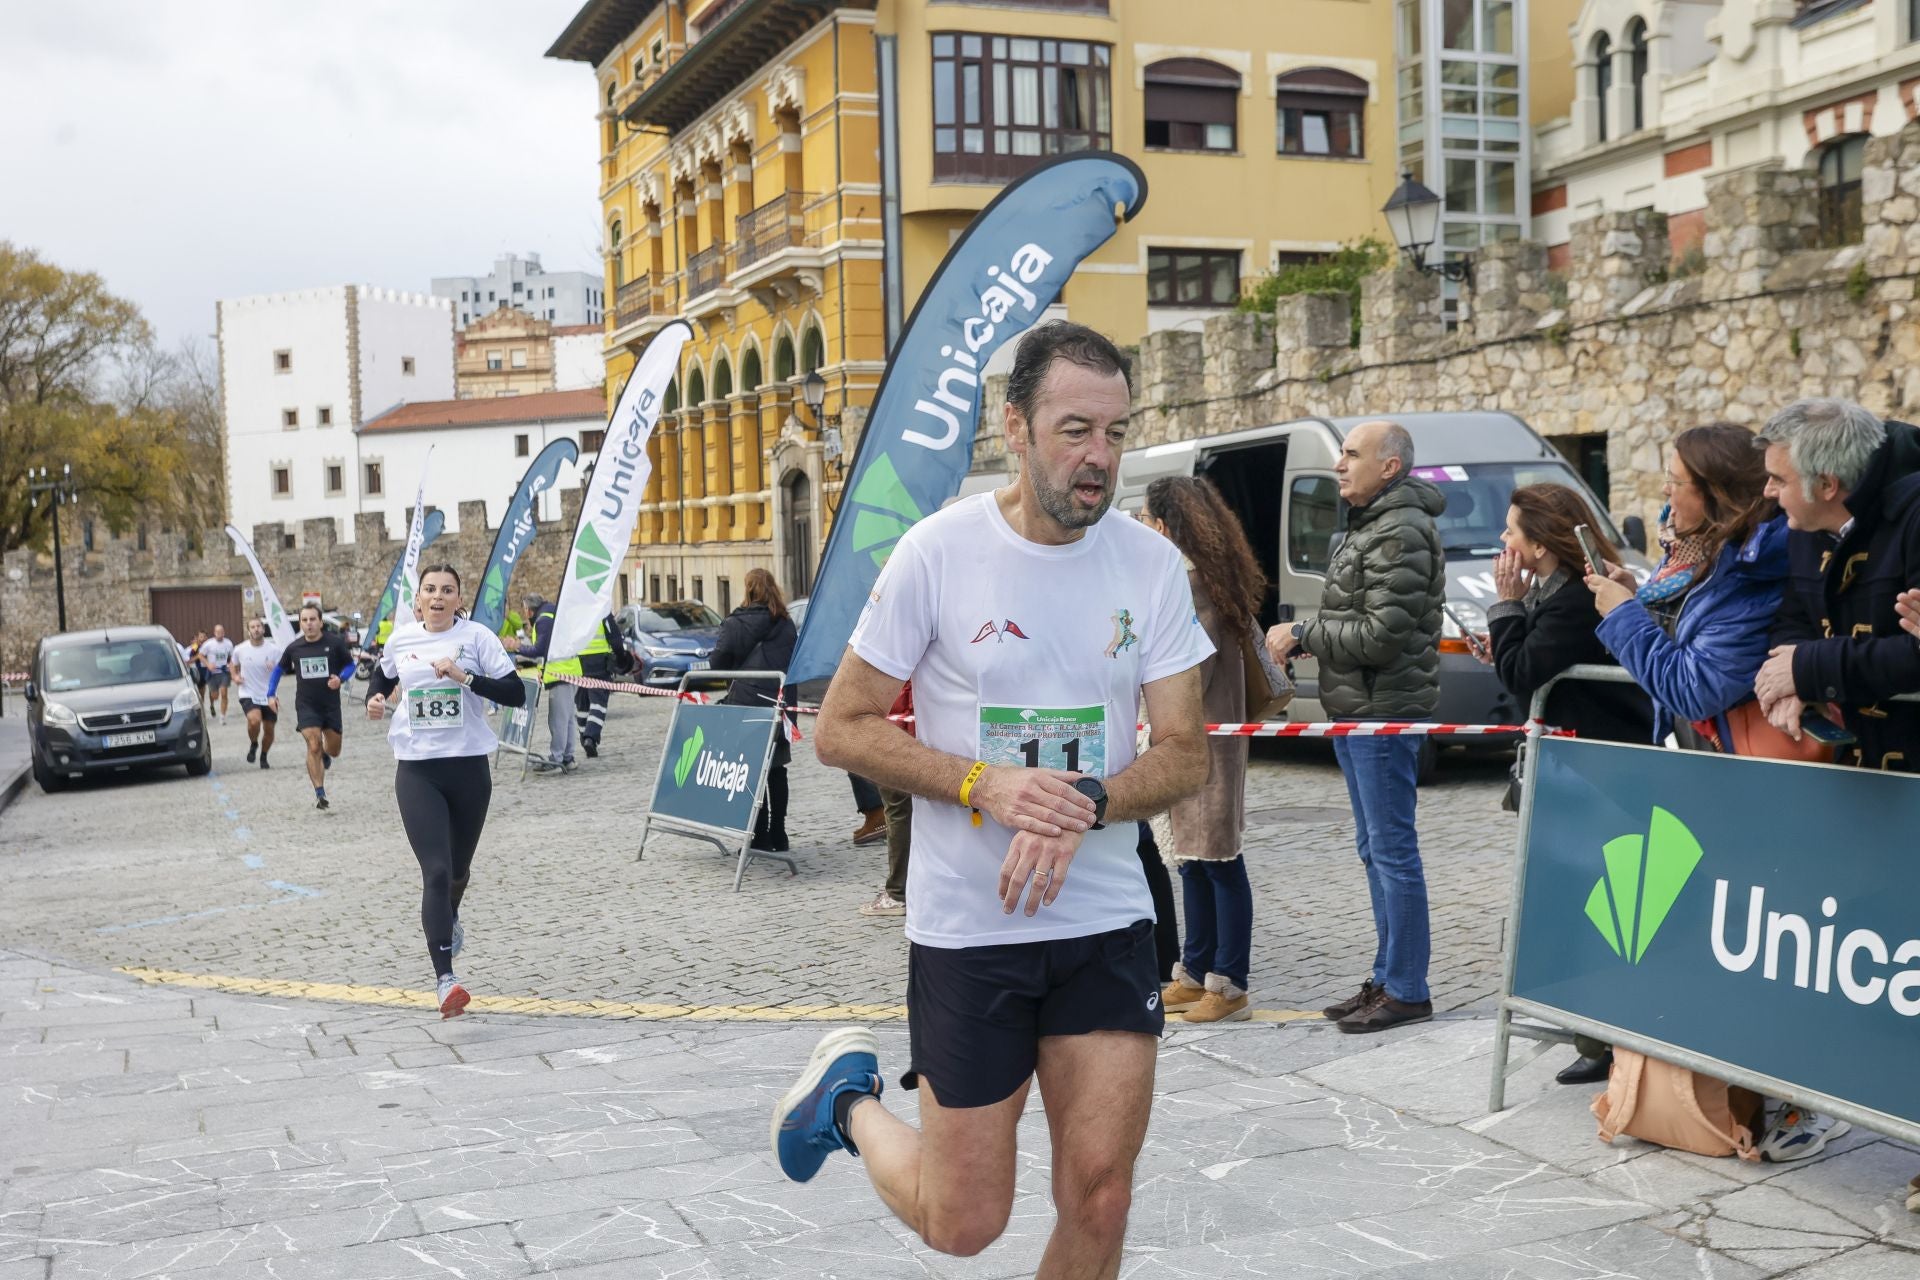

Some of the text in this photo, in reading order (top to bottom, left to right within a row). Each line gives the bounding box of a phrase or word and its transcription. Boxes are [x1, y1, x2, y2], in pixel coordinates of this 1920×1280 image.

[901, 243, 1053, 450] Unicaja
[600, 388, 656, 520] Unicaja
[503, 474, 546, 564] Unicja
[416, 700, 460, 718] 183
[986, 730, 1022, 738] Solidarios
[1037, 731, 1075, 739] PROYECTO
[999, 723, 1025, 731] Carrera
[696, 750, 749, 802] Unicaja
